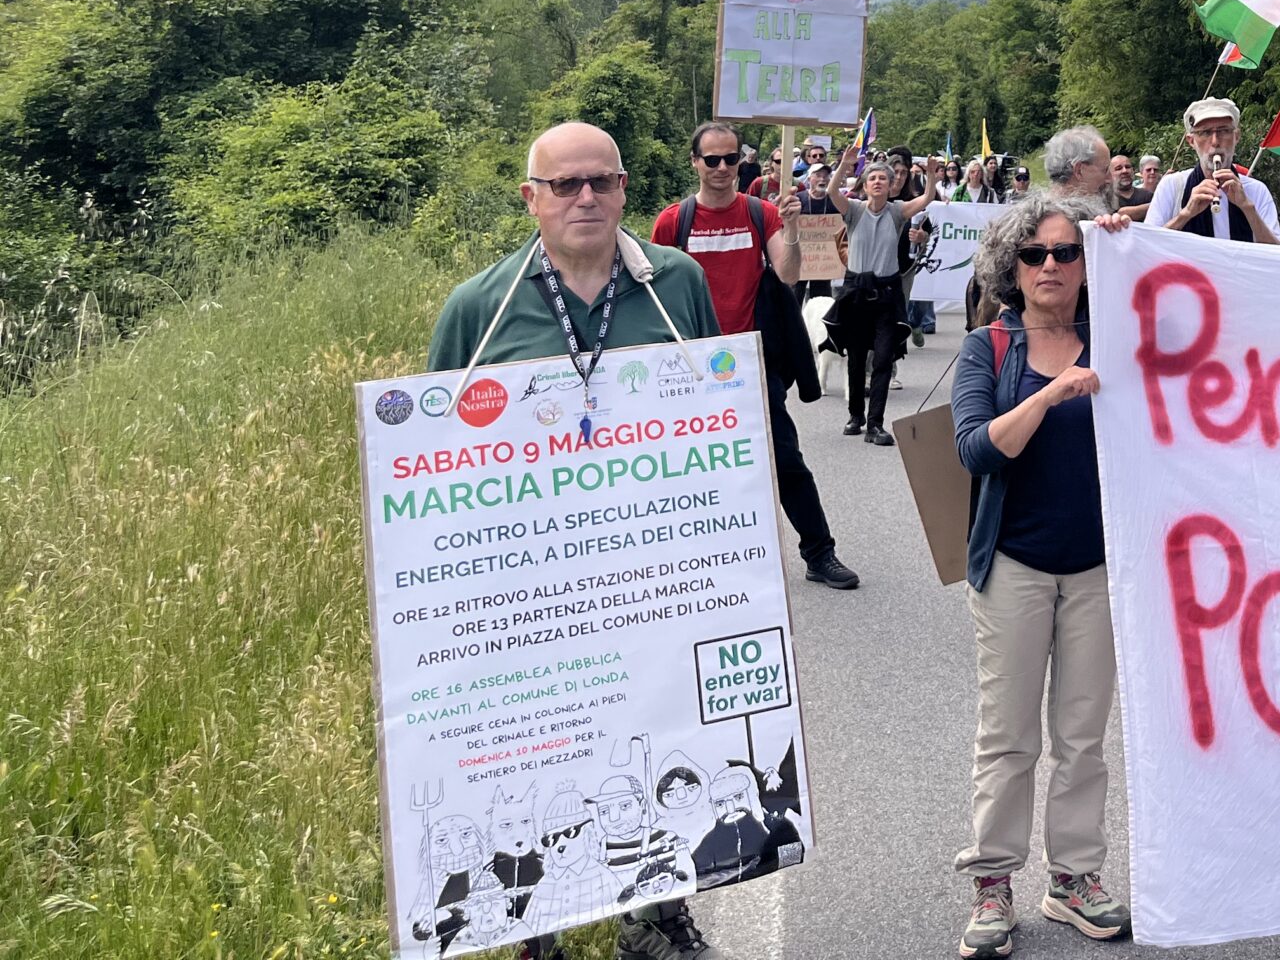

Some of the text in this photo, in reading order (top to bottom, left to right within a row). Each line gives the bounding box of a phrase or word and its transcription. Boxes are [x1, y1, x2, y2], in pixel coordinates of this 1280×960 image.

[753, 10, 812, 40] ALLA
[725, 48, 841, 104] TERRA
[470, 386, 504, 401] Italia
[658, 376, 694, 387] CRINALI
[660, 387, 695, 398] LIBERI
[460, 398, 504, 413] Nostra
[393, 408, 738, 479] SABATO 9 MAGGIO 2026
[383, 438, 754, 524] MARCIA POPOLARE
[434, 489, 720, 551] CONTRO LA SPECULAZIONE
[396, 510, 757, 589] ENERGETICA, A DIFESA DEI CRINALI
[392, 546, 766, 625] ORE 12 RITROVO ALLA STAZIONE DI CONTEA (FI)
[452, 577, 716, 637] ORE 13 PARTENZA DELLA MARCIA
[417, 592, 750, 668] ARRIVO IN PIAZZA DEL COMUNE DI LONDA
[719, 640, 762, 669] NO
[407, 671, 630, 725] DAVANTI AL COMUNE DI LONDA
[411, 651, 622, 702] ORE 16 ASSEMBLEA PUBBLICA
[705, 663, 780, 691] energy
[428, 693, 627, 742] A SEGUIRE CENA IN COLONICA AI PIEDI
[707, 685, 783, 713] for war
[458, 730, 607, 768] DOMENICA 10 MAGGIO PER IL
[467, 716, 592, 750] DEL CRINALE E RITORNO
[467, 748, 593, 783] SENTIERO DEI MEZZADRI
